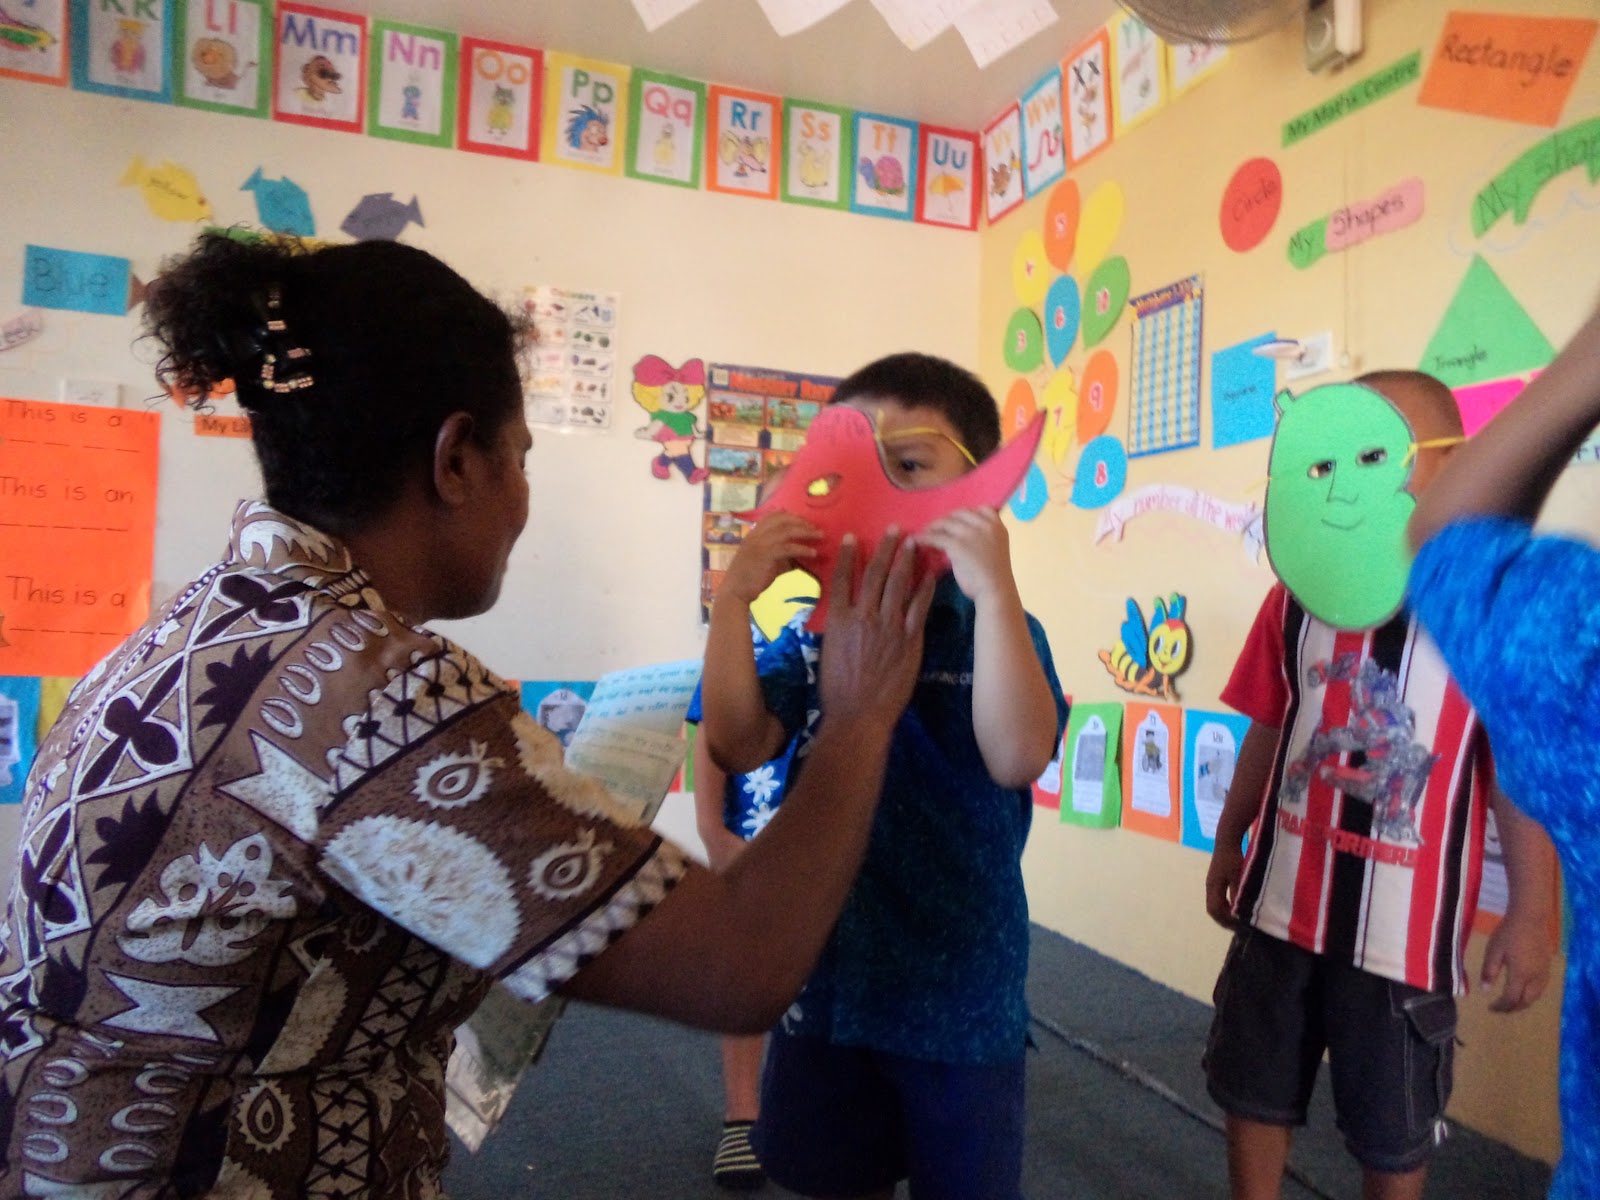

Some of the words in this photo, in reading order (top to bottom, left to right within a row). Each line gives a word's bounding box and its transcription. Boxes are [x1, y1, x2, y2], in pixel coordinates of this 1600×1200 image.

[281, 14, 357, 56] Mm
[388, 31, 441, 71] Nn
[475, 50, 528, 85] Oo
[1444, 33, 1574, 88] Rectangle
[572, 69, 614, 109] Pp
[644, 86, 693, 128] Qq
[731, 100, 762, 131] Rr
[801, 111, 831, 142] Ss
[872, 123, 897, 153] Tt
[933, 138, 967, 170] Uu
[1289, 230, 1315, 259] My
[1333, 194, 1405, 236] Shapes
[32, 256, 110, 298] Blue
[1089, 381, 1104, 412] 9
[5, 400, 56, 423] This
[70, 408, 87, 424] is
[107, 414, 123, 428] a
[202, 418, 226, 434] My
[0, 476, 48, 500] This
[64, 478, 87, 501] is
[104, 488, 134, 504] an
[1094, 461, 1109, 488] 8
[5, 575, 65, 606] This
[75, 586, 98, 607] is
[111, 590, 126, 608] a
